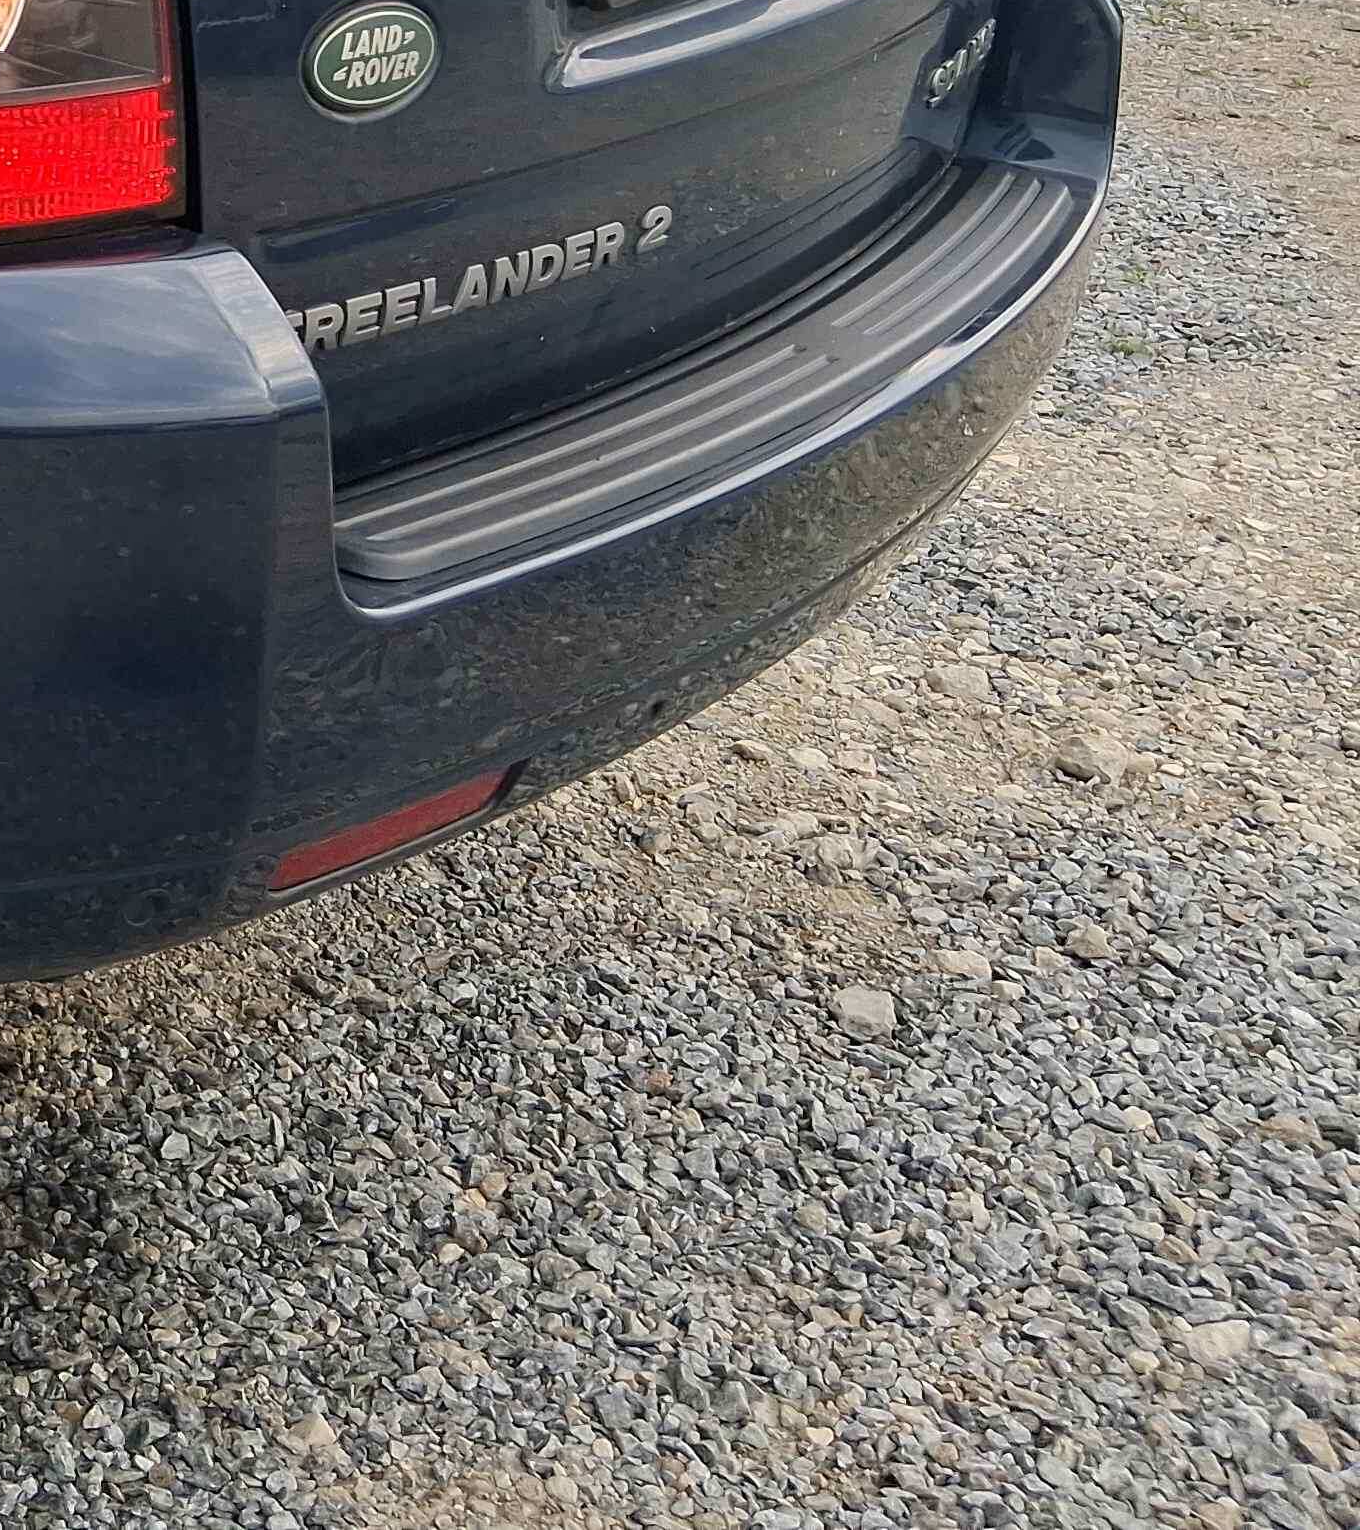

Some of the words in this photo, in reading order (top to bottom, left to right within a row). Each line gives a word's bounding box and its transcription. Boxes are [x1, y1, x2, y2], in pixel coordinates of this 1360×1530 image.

[341, 24, 403, 61] LAND
[346, 51, 420, 90] ROVER
[636, 205, 673, 255] 2
